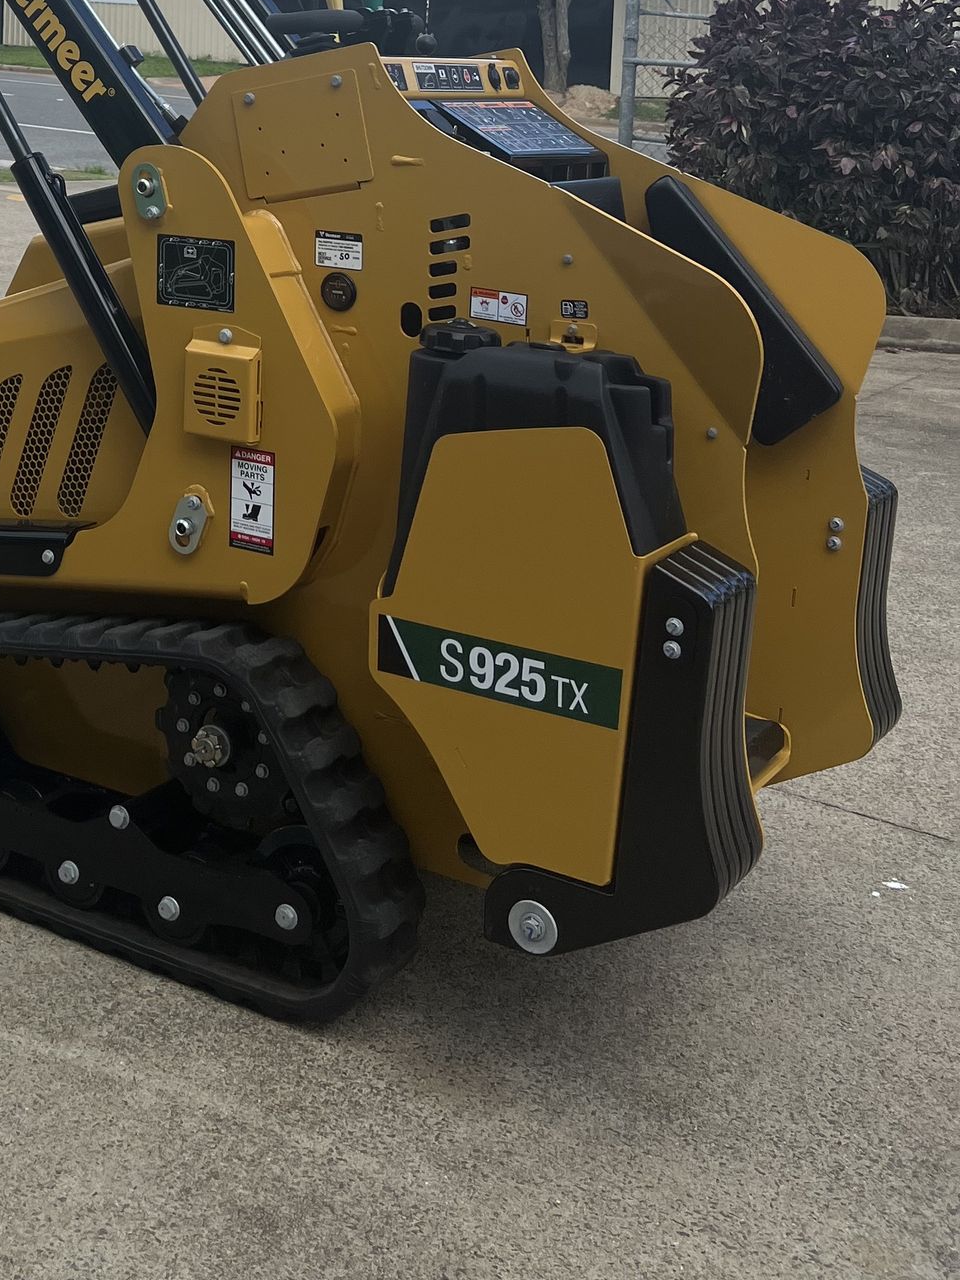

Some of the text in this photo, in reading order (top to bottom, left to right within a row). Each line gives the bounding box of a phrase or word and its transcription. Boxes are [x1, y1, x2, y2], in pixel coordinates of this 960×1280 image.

[339, 252, 350, 261] 50
[241, 451, 272, 463] DANGER
[237, 461, 268, 473] MOVING
[240, 470, 266, 482] PARTS
